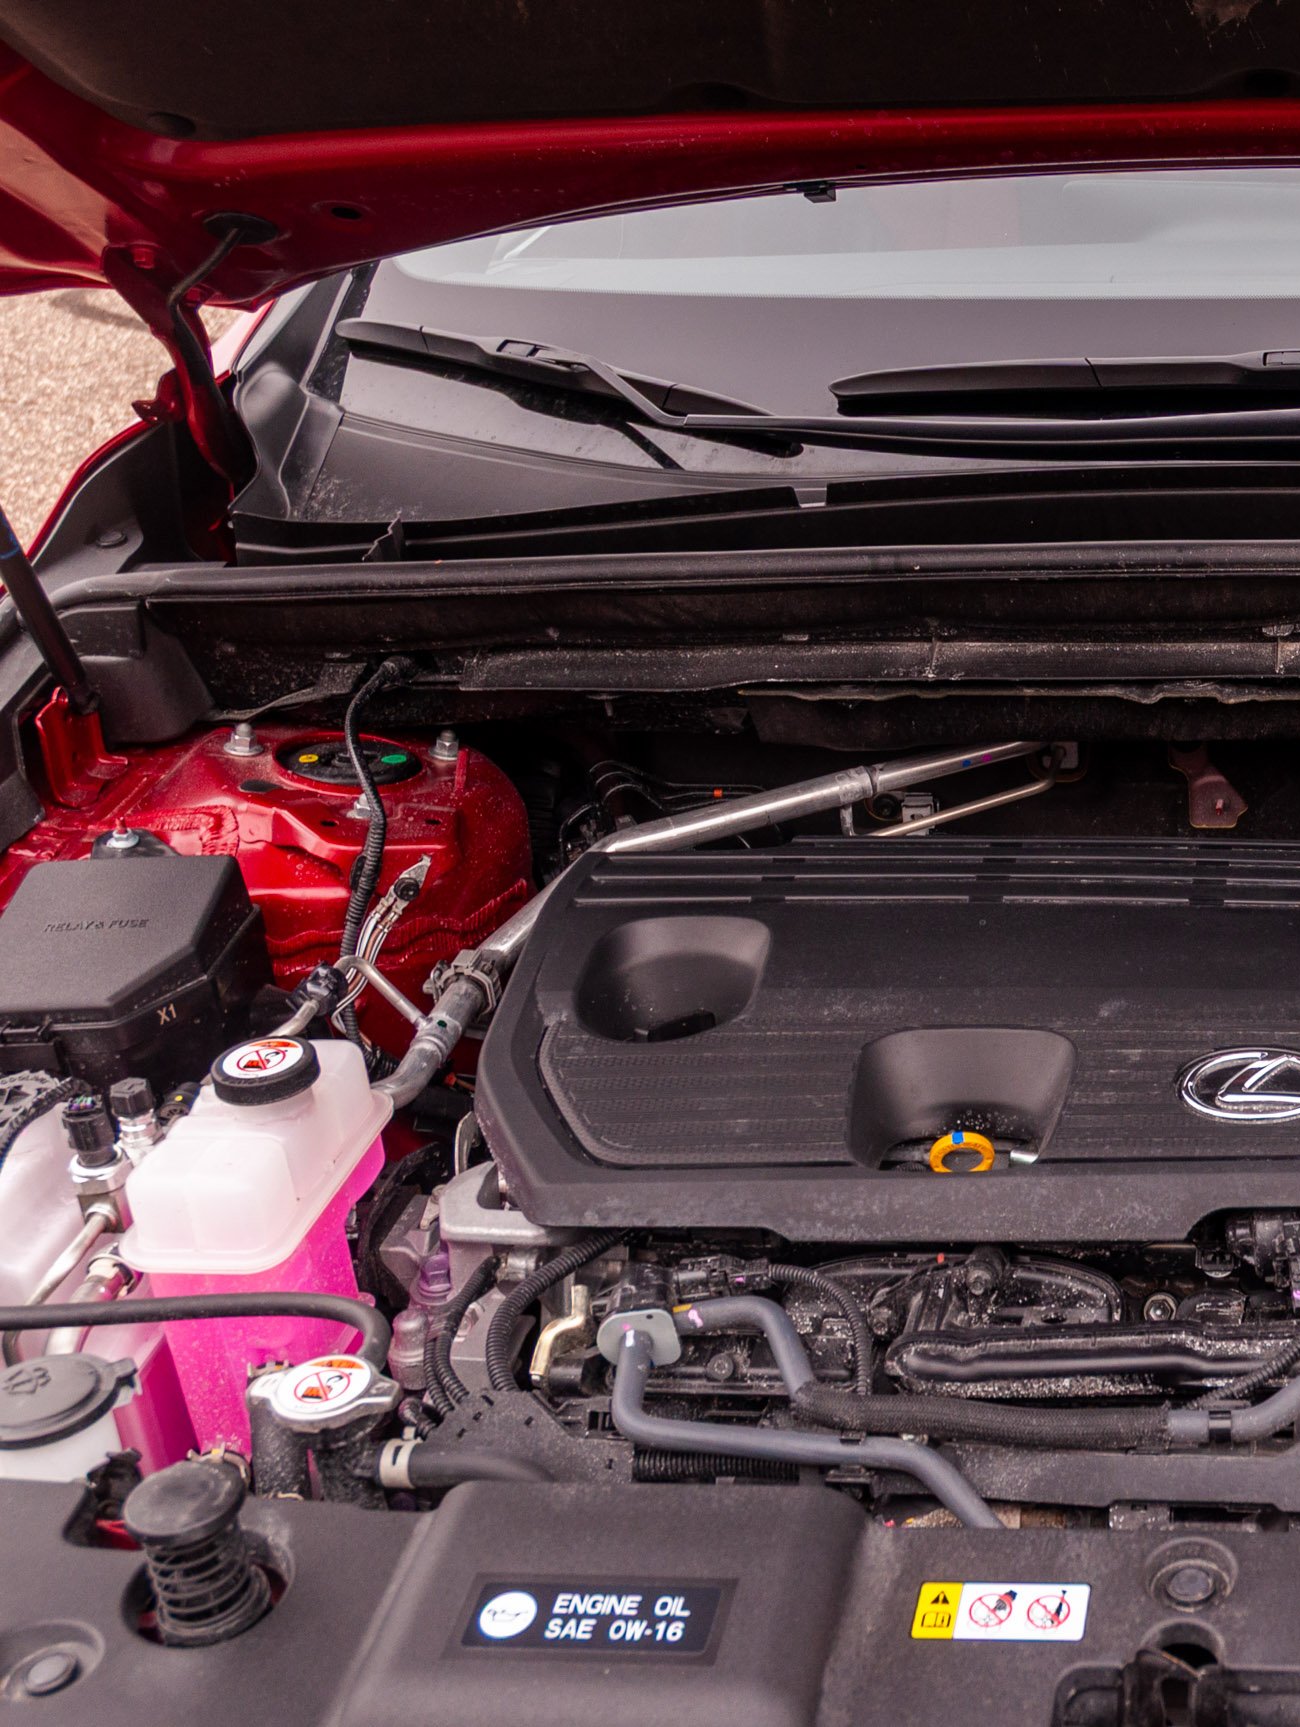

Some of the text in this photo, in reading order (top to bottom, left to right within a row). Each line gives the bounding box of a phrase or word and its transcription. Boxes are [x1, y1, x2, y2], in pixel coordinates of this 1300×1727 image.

[45, 920, 94, 932] RELAY
[108, 918, 150, 929] FUSE
[156, 1003, 177, 1025] X1
[552, 1593, 691, 1617] ENGINE OIL
[544, 1618, 686, 1642] SAE 0W-16
